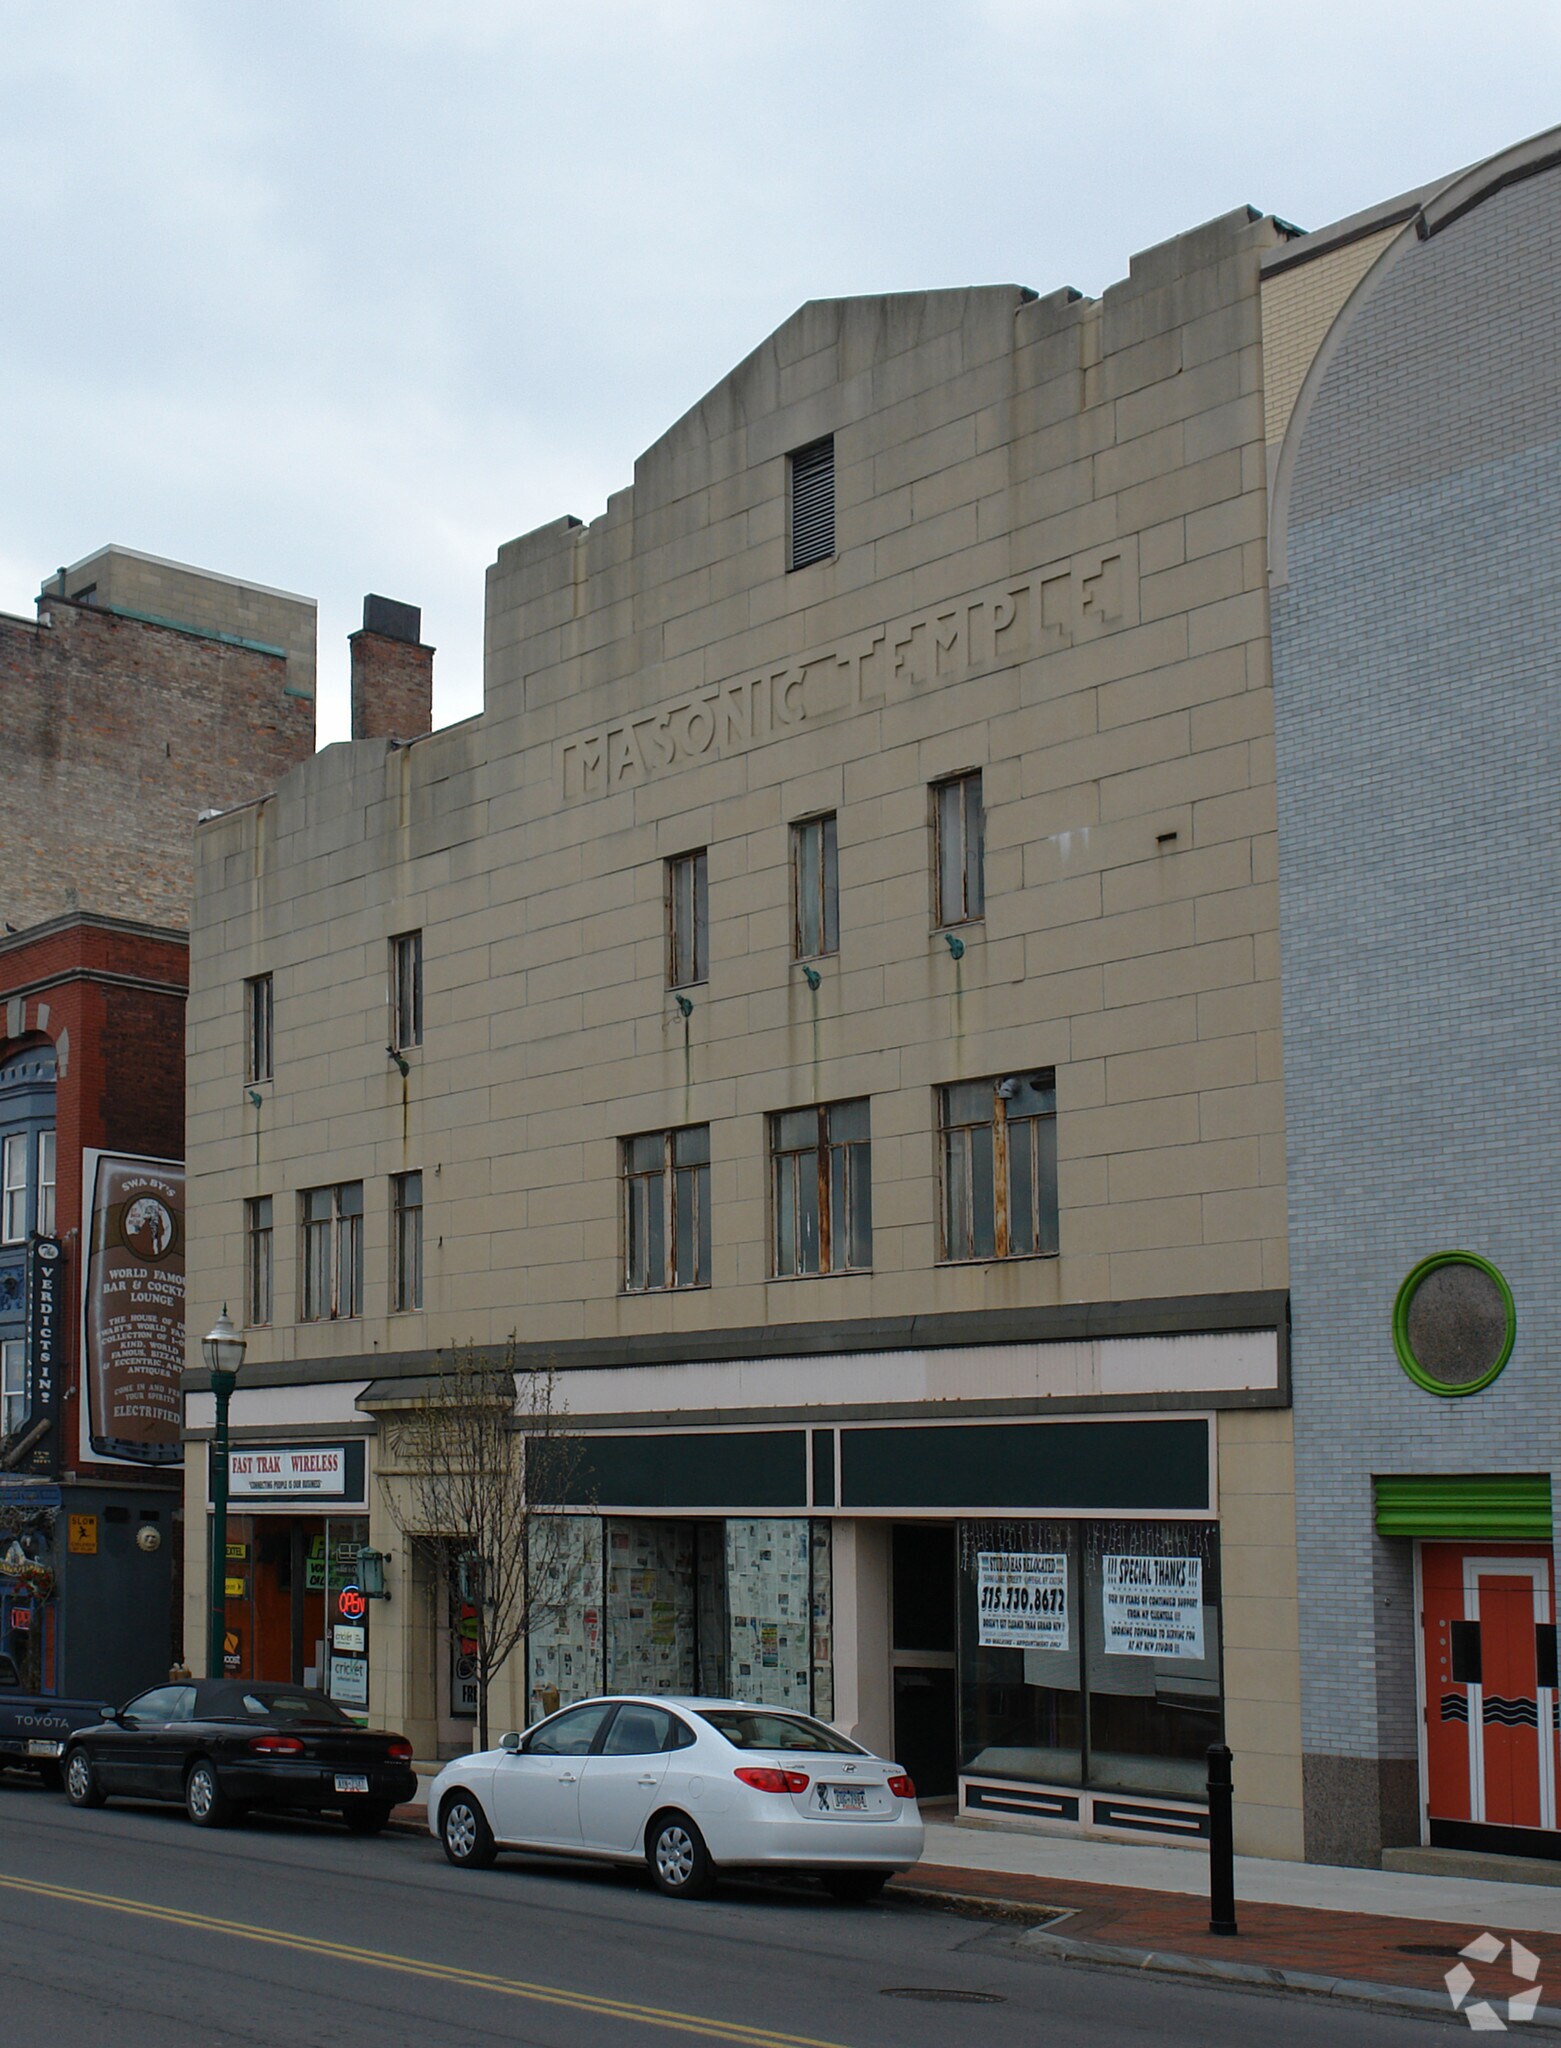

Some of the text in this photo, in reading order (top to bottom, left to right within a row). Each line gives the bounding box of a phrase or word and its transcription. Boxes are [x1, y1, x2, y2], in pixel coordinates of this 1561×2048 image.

[572, 562, 1105, 793] MASONIC TEMPLE
[121, 1177, 176, 1197] SWABY'S
[109, 1268, 148, 1280] WORLD
[103, 1281, 127, 1294] BAR
[132, 1279, 142, 1291] &
[130, 1292, 174, 1307] LOUNGE
[39, 1266, 54, 1362] VERDICTS
[109, 1315, 127, 1326] THE
[130, 1314, 158, 1322] HOUSE
[161, 1317, 173, 1325] OF
[137, 1323, 167, 1332] WORLD
[101, 1331, 152, 1345] COLLECTION
[156, 1333, 168, 1341] OF
[149, 1341, 179, 1354] WORLD
[128, 1365, 172, 1377] ANTIQUES
[114, 1384, 134, 1396] COME
[137, 1383, 145, 1391] IN
[149, 1383, 165, 1393] AND
[125, 1391, 176, 1405] YOUR SPIRITS
[113, 1404, 180, 1425] ELECTRIFIED
[232, 1454, 340, 1474] FAST TRAK WIRELESS
[274, 1480, 288, 1489] PEOPLE
[1120, 1558, 1152, 1585] SPECIAL
[1154, 1559, 1187, 1588] THANKS
[339, 1592, 366, 1613] OPEN
[1109, 1593, 1118, 1605] FOR
[1149, 1596, 1176, 1608] CONTINUED
[1177, 1597, 1199, 1609] SUPPORT
[1127, 1608, 1141, 1619] FROM
[1111, 1625, 1133, 1638] LOOKING
[1134, 1626, 1158, 1639] FORWARD
[1159, 1627, 1166, 1639] TO
[1166, 1628, 1185, 1641] SERVING
[1155, 1642, 1174, 1654] STUDIO
[335, 1658, 363, 1677] cricket
[462, 1684, 477, 1703] FRE
[15, 1715, 69, 1728] TOYOTA
